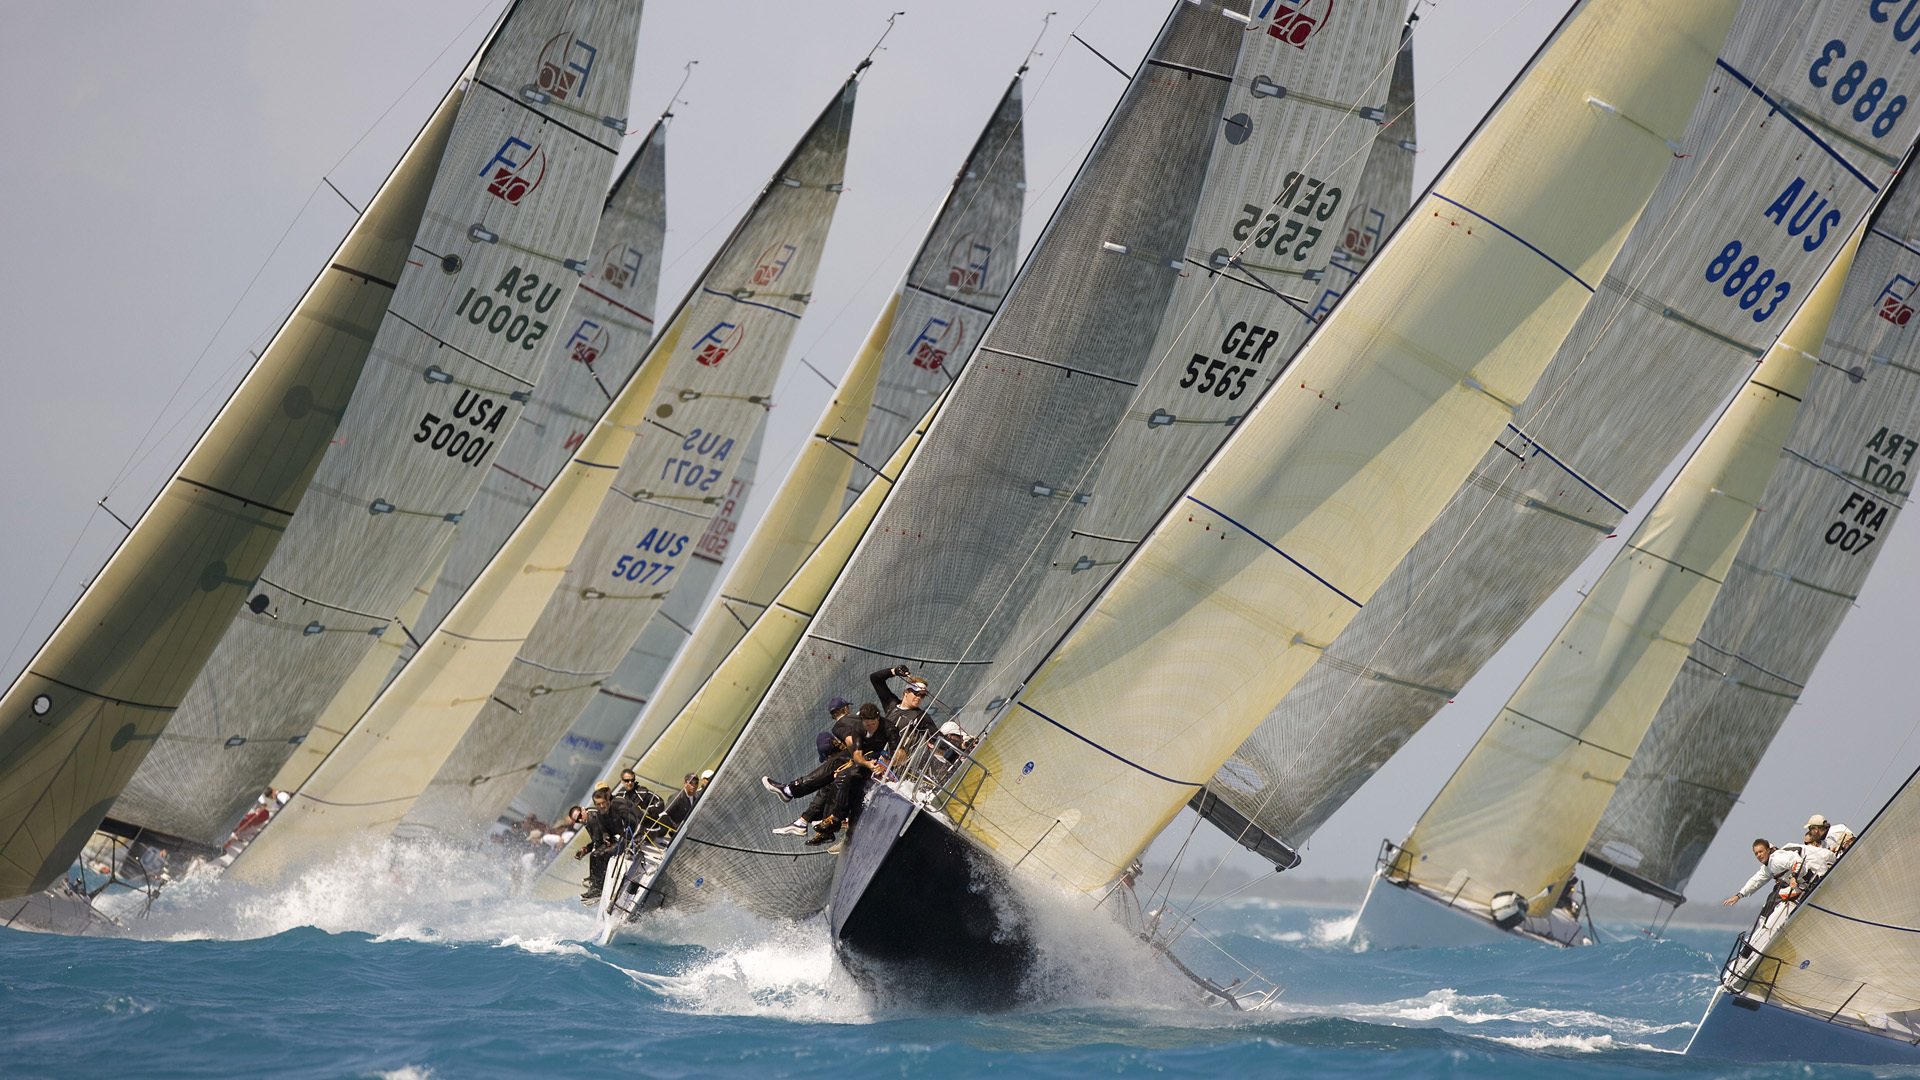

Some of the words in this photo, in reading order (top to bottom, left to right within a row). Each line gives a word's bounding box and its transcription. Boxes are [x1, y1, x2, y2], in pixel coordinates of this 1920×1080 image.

[1763, 176, 1841, 252] AUS
[1705, 240, 1791, 323] 8883
[1221, 321, 1279, 364] GER
[1180, 353, 1257, 401] 5565
[453, 389, 508, 434] USA
[413, 412, 494, 467] 50001
[1838, 491, 1889, 532] FRA
[636, 528, 689, 557] AUS
[1824, 521, 1875, 556] 007
[612, 555, 675, 586] 5077
